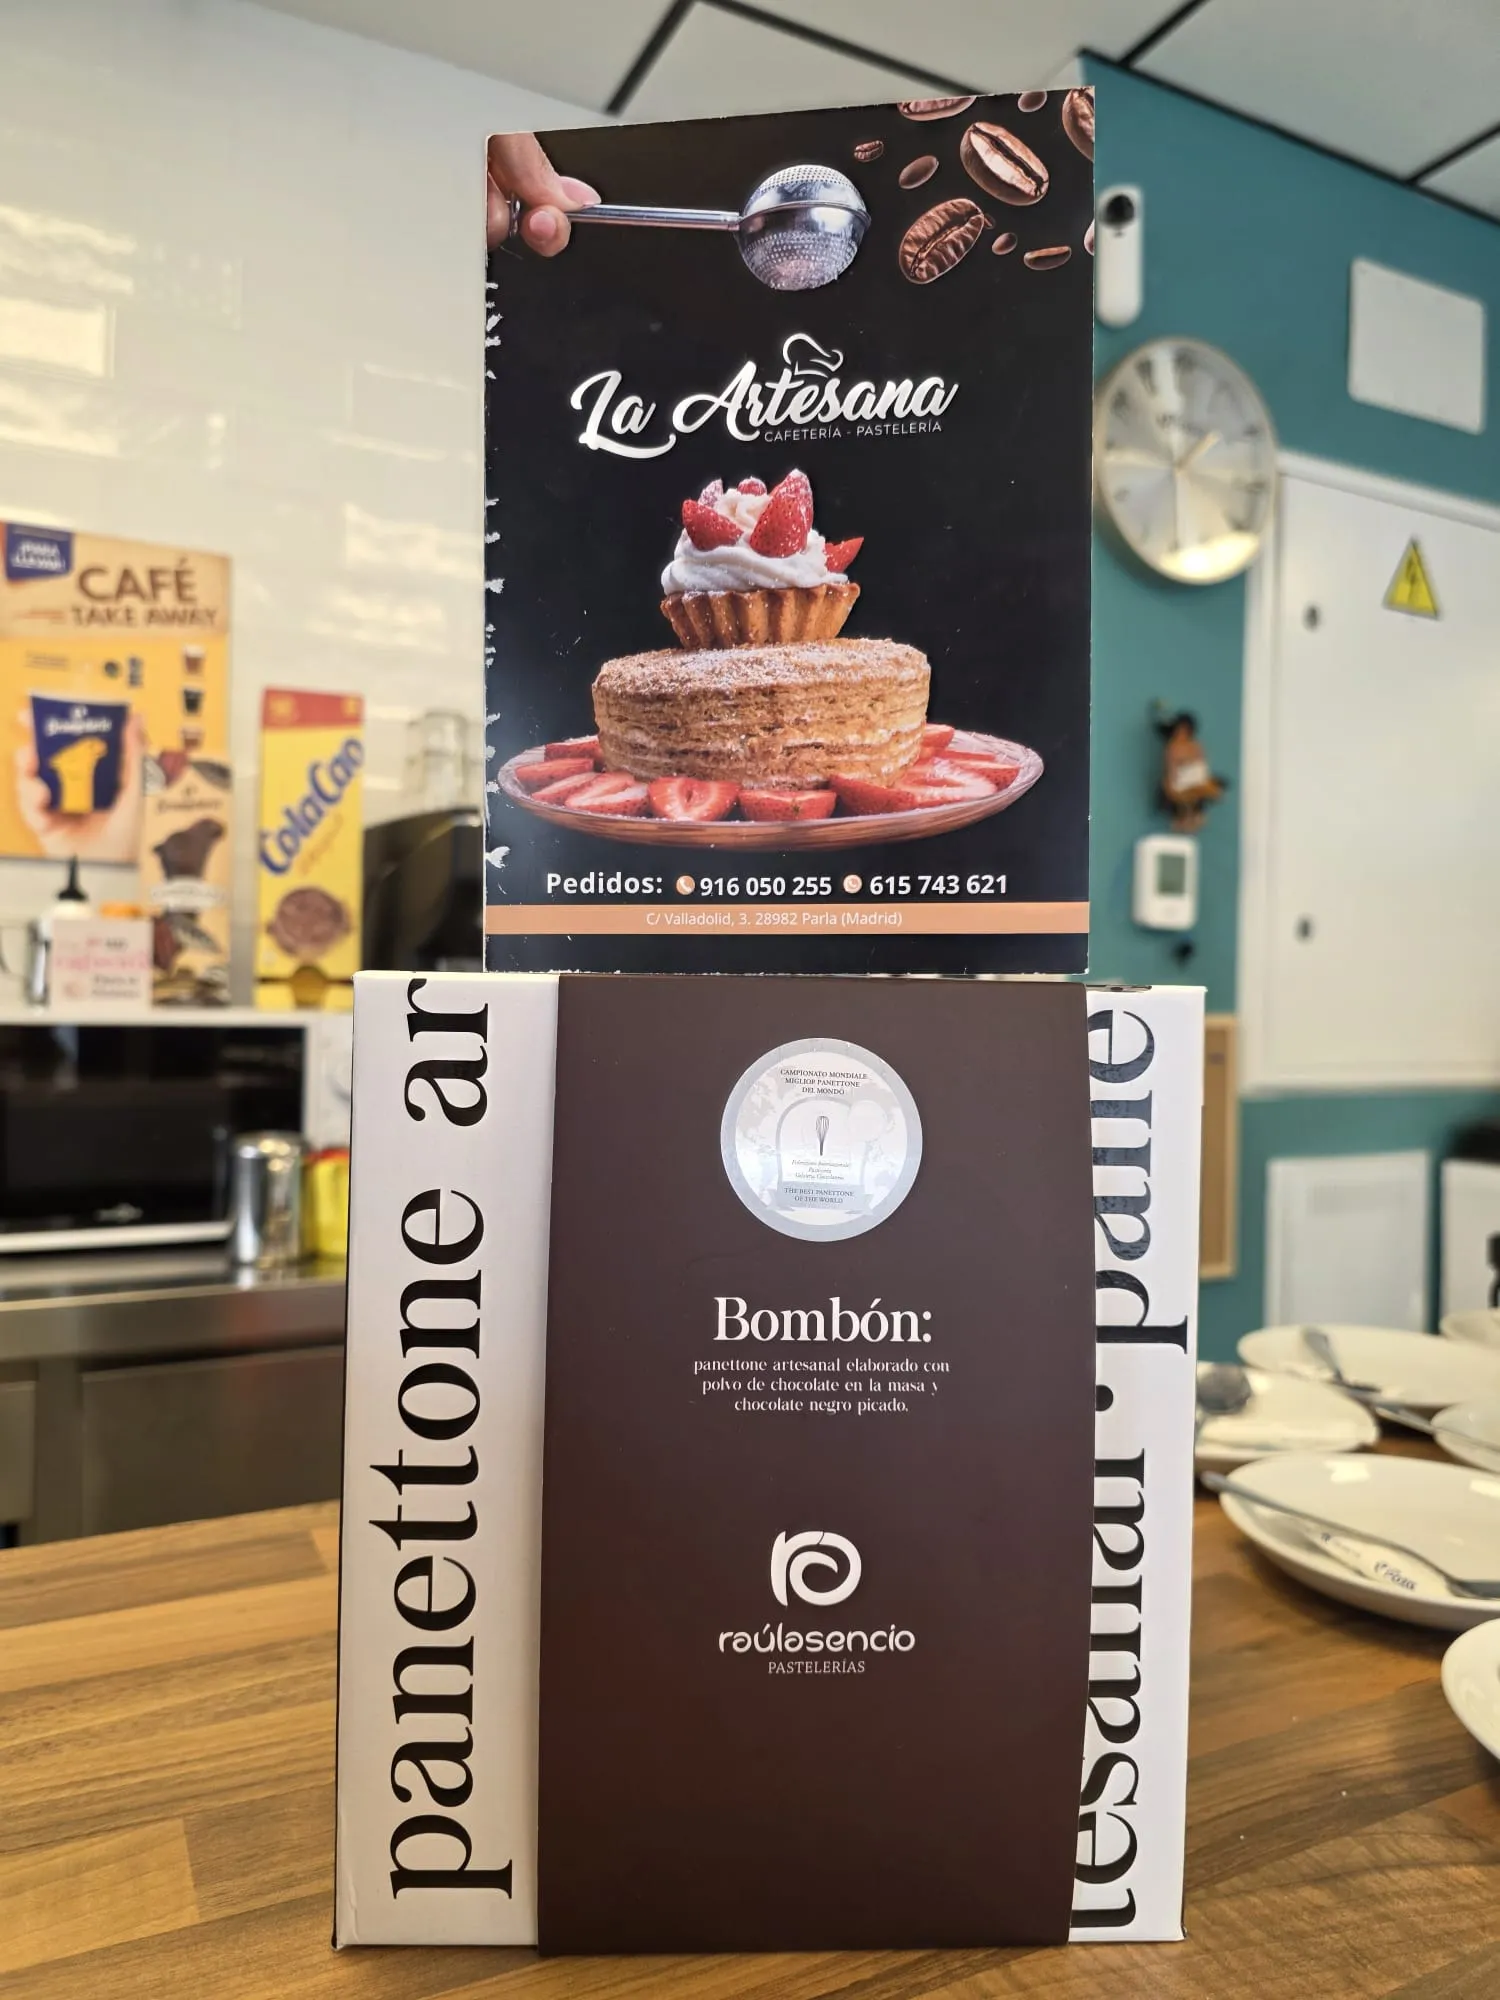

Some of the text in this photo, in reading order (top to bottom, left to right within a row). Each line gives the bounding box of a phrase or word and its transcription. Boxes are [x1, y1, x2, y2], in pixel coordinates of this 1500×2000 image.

[570, 360, 959, 459] La Artesana
[764, 425, 843, 443] CAFETERÍA
[856, 420, 943, 436] PASTELERÍA
[77, 556, 198, 603] CAFÉ
[71, 604, 137, 626] TAKE
[145, 606, 218, 627] AWAY
[547, 872, 1007, 896] Pedidos: 916 050 255 615 743 621
[646, 912, 661, 926] C/
[664, 911, 735, 928] Valladolid,
[755, 912, 797, 926] 28982
[802, 911, 837, 926] Parla
[841, 911, 903, 927] (Madrid)
[780, 1069, 868, 1080] CAMPIONATO MONDIALE
[818, 1080, 861, 1088] PANETTONE
[815, 1189, 854, 1197] PANETTONE
[713, 1296, 932, 1343] Bombón:
[694, 1358, 950, 1375] panettone artesanal elaborado con
[702, 1377, 938, 1397] polvo de chocolate en la masa y
[734, 1398, 909, 1416] chocolate negro picado.
[369, 978, 512, 1899] panettone ar
[718, 1622, 916, 1653] raúlasencio
[768, 1659, 866, 1674] PASTELERÍAS
